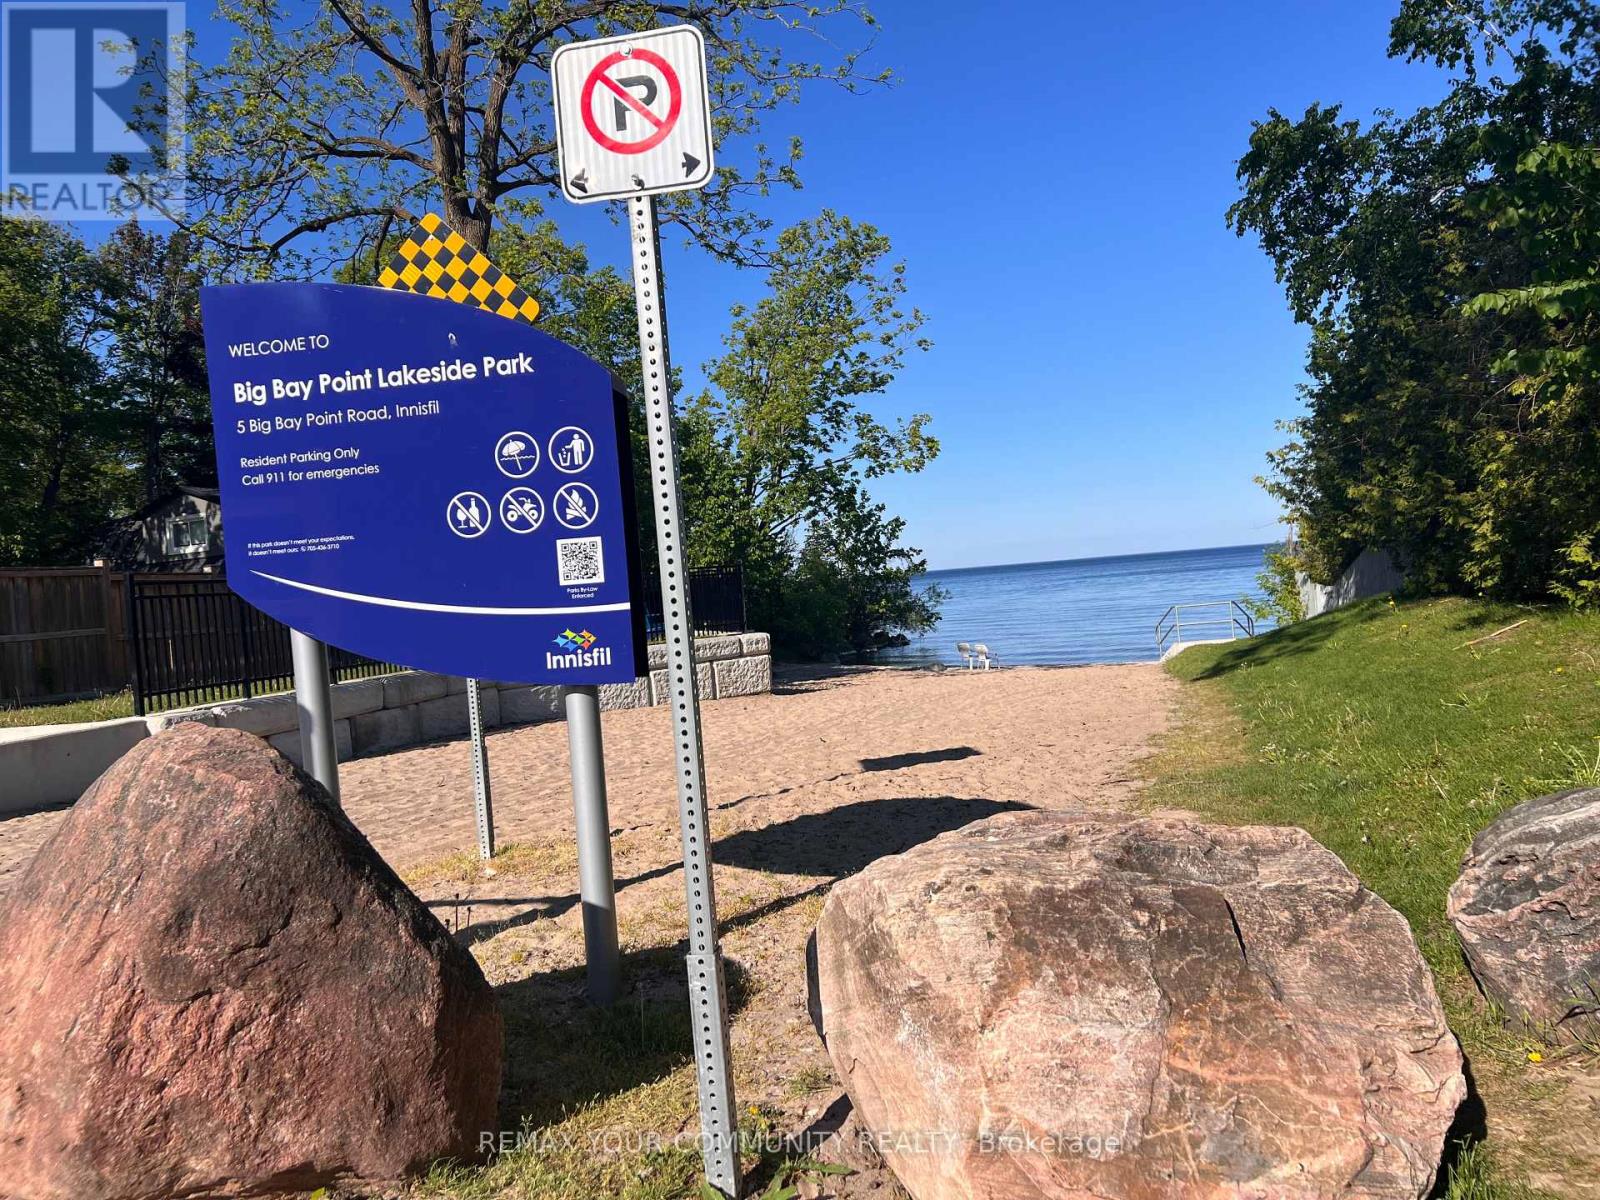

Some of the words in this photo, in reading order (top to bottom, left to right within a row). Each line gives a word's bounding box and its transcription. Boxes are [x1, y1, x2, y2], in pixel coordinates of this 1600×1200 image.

[614, 75, 658, 132] P
[229, 337, 306, 358] WELCOME
[308, 334, 329, 349] TO
[233, 381, 267, 406] Big
[272, 378, 313, 401] Bay
[319, 368, 372, 394] Point
[377, 359, 478, 388] Lakeside
[482, 352, 535, 377] Park
[236, 420, 245, 434] 5
[250, 419, 271, 435] Big
[275, 416, 302, 431] Bay
[306, 410, 343, 427] Point
[347, 405, 392, 423] Road,
[395, 400, 440, 418] Innisfil
[240, 453, 288, 468] Resident
[290, 450, 331, 463] Parking
[334, 447, 360, 460] Only
[242, 474, 265, 486] Call
[266, 472, 285, 483] 911
[288, 471, 303, 481] for
[306, 464, 380, 479] emergencies
[253, 548, 273, 556] doesn't
[273, 547, 287, 555] meet
[261, 541, 273, 549] park
[307, 537, 319, 545] your
[546, 647, 612, 670] Innisfil
